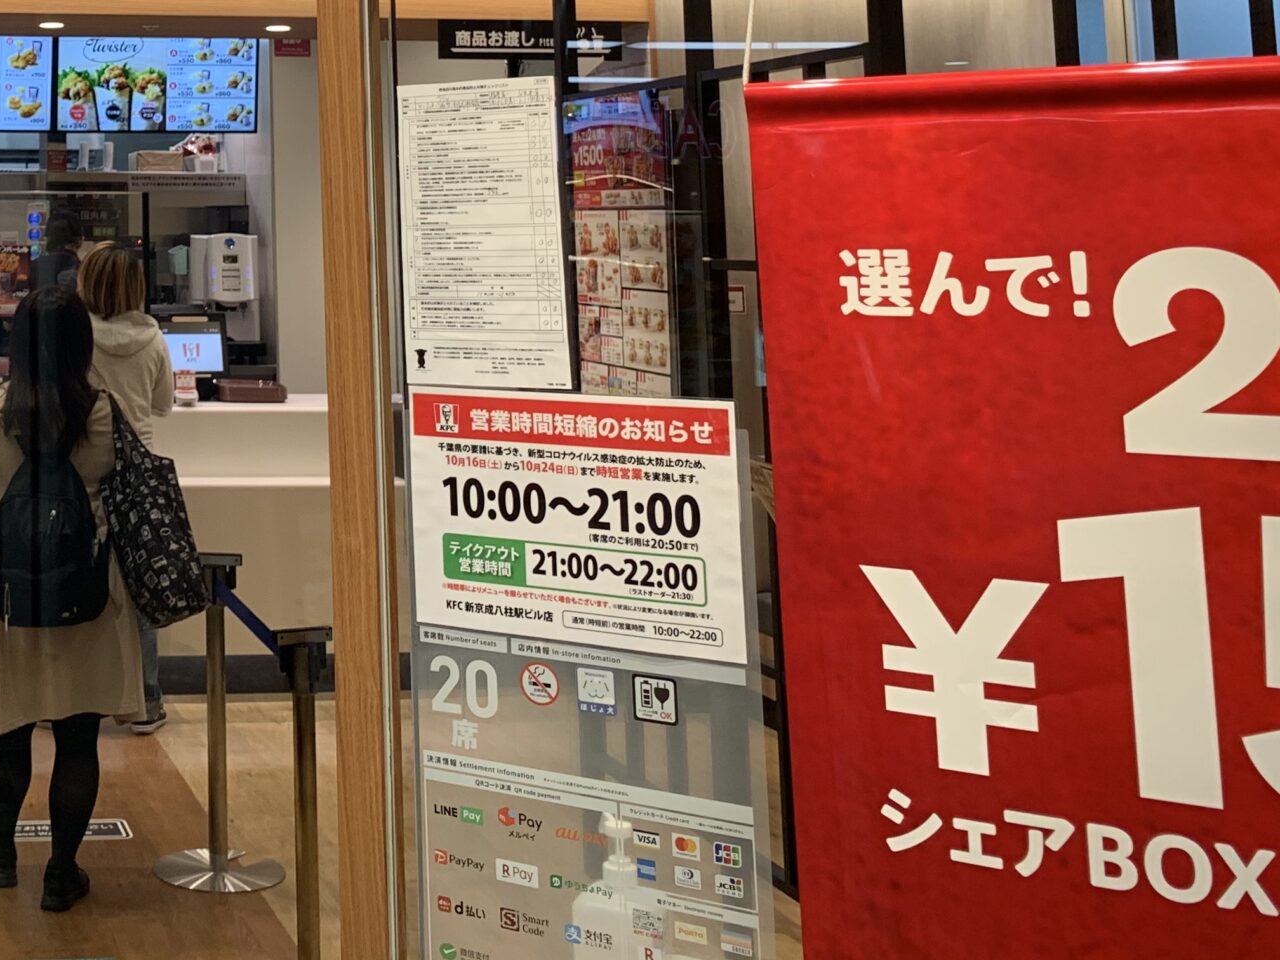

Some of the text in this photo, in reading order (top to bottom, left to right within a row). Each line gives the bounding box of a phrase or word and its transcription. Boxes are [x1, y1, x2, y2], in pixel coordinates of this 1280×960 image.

[455, 29, 535, 47] 商品お渡し
[838, 248, 1092, 320] 選んで!
[439, 424, 456, 432] KFC
[470, 408, 714, 444] 営業時間短縮のお知らせ
[442, 476, 701, 538] 10:00〜21:00
[449, 541, 520, 562] テイクアウト
[459, 558, 512, 577] 営業時間
[532, 548, 698, 592] 21:00〜22:00
[446, 599, 554, 623] KFC 新京成八柱駅ビル店
[445, 633, 472, 644] Number
[472, 636, 479, 645] of
[479, 639, 497, 648] seats
[517, 643, 550, 656] 店内情報
[429, 655, 498, 719] 20
[660, 711, 673, 722] OK
[451, 718, 479, 751] 席
[426, 754, 457, 768] 決済情報
[459, 760, 495, 775] Settlement
[433, 803, 481, 824] LINE Pay
[518, 812, 543, 831] Pay
[508, 830, 536, 842] メルペイ
[554, 826, 581, 842] au
[636, 834, 657, 846] VISA
[449, 853, 485, 873] PayPay
[502, 863, 534, 883] R Pay
[716, 882, 736, 892] JCB
[522, 912, 549, 928] Smart
[522, 925, 545, 938] Code
[583, 929, 613, 947] 支付宝
